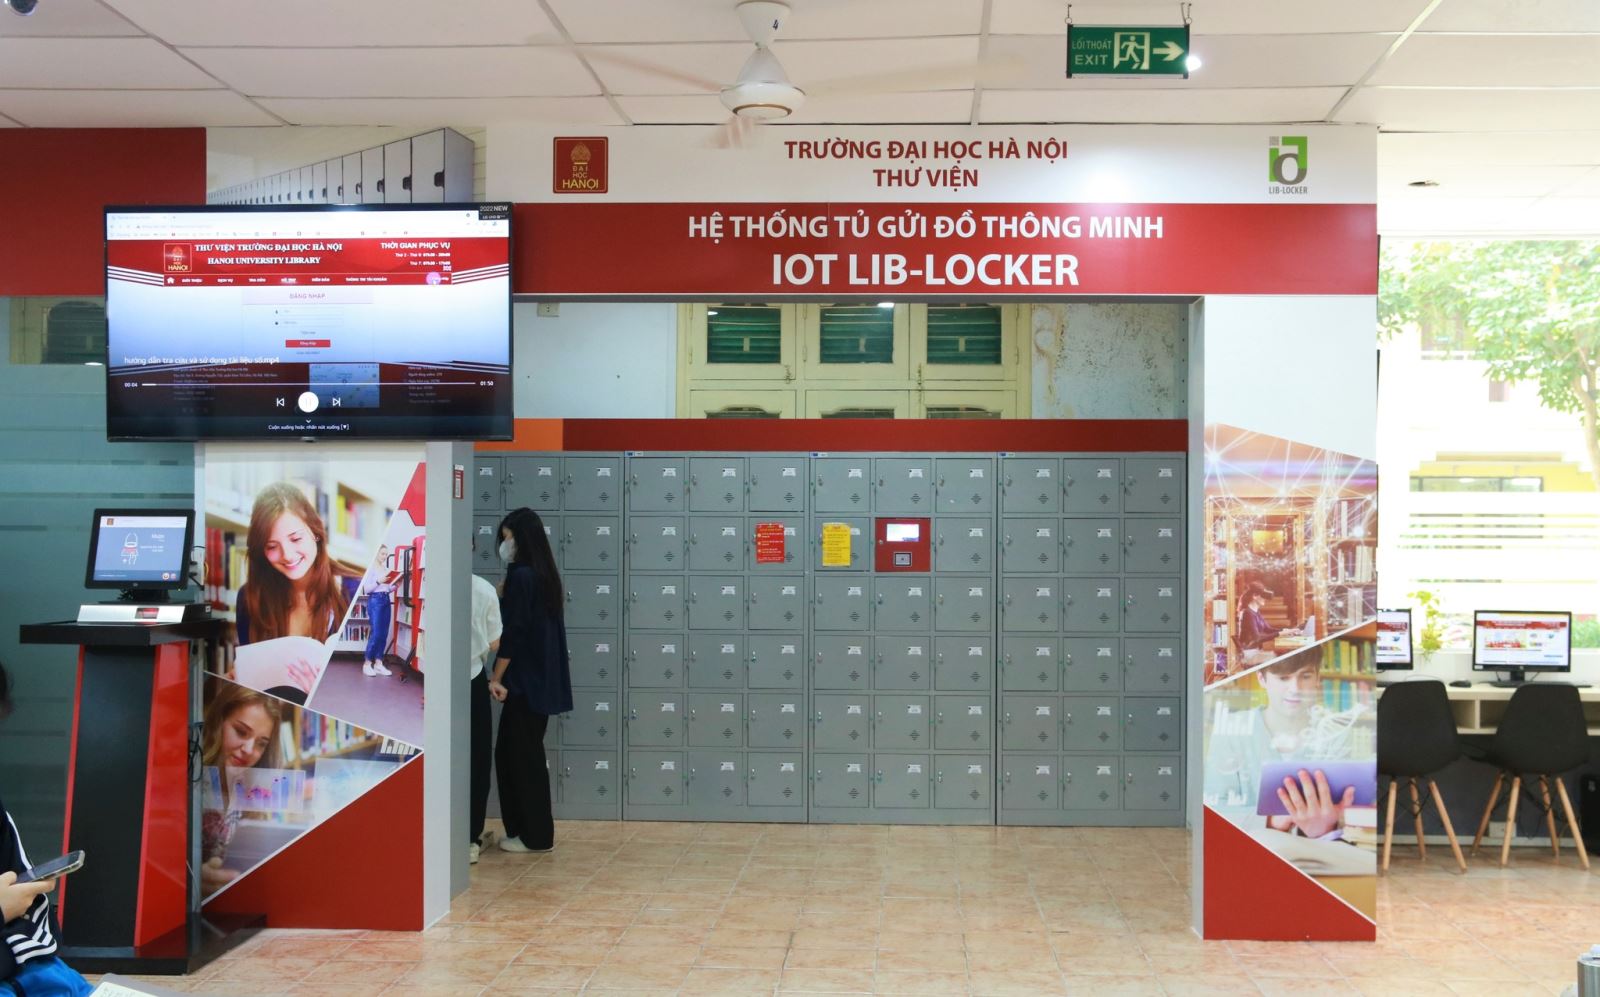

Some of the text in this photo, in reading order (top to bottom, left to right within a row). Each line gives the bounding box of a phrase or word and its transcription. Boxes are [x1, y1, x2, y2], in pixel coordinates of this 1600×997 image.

[1072, 37, 1112, 49] LỐI THOÁT
[1075, 54, 1108, 65] EXIT
[784, 137, 1067, 163] TRƯỜNG ĐẠI HỌC HÀ NỘI
[873, 165, 979, 192] THƯ VIỆN
[1268, 186, 1308, 194] LIB-LOCKER
[688, 209, 1164, 244] HỆ THỐNG TỦ GỬI ĐỒ THÔNG MINH
[215, 243, 236, 252] VIỆN
[238, 242, 274, 251] TRƯỜNG
[275, 243, 290, 252] ĐẠI
[292, 243, 311, 252] HỌC
[312, 241, 325, 250] HÀ
[326, 242, 343, 252] NỘI
[380, 241, 398, 249] THỜI
[419, 242, 439, 250] PHỤC
[440, 242, 450, 250] VỤ
[236, 257, 285, 265] UNIVERSITY
[285, 256, 321, 264] LIBRARY
[774, 253, 1080, 286] IOT LIB-LOCKER
